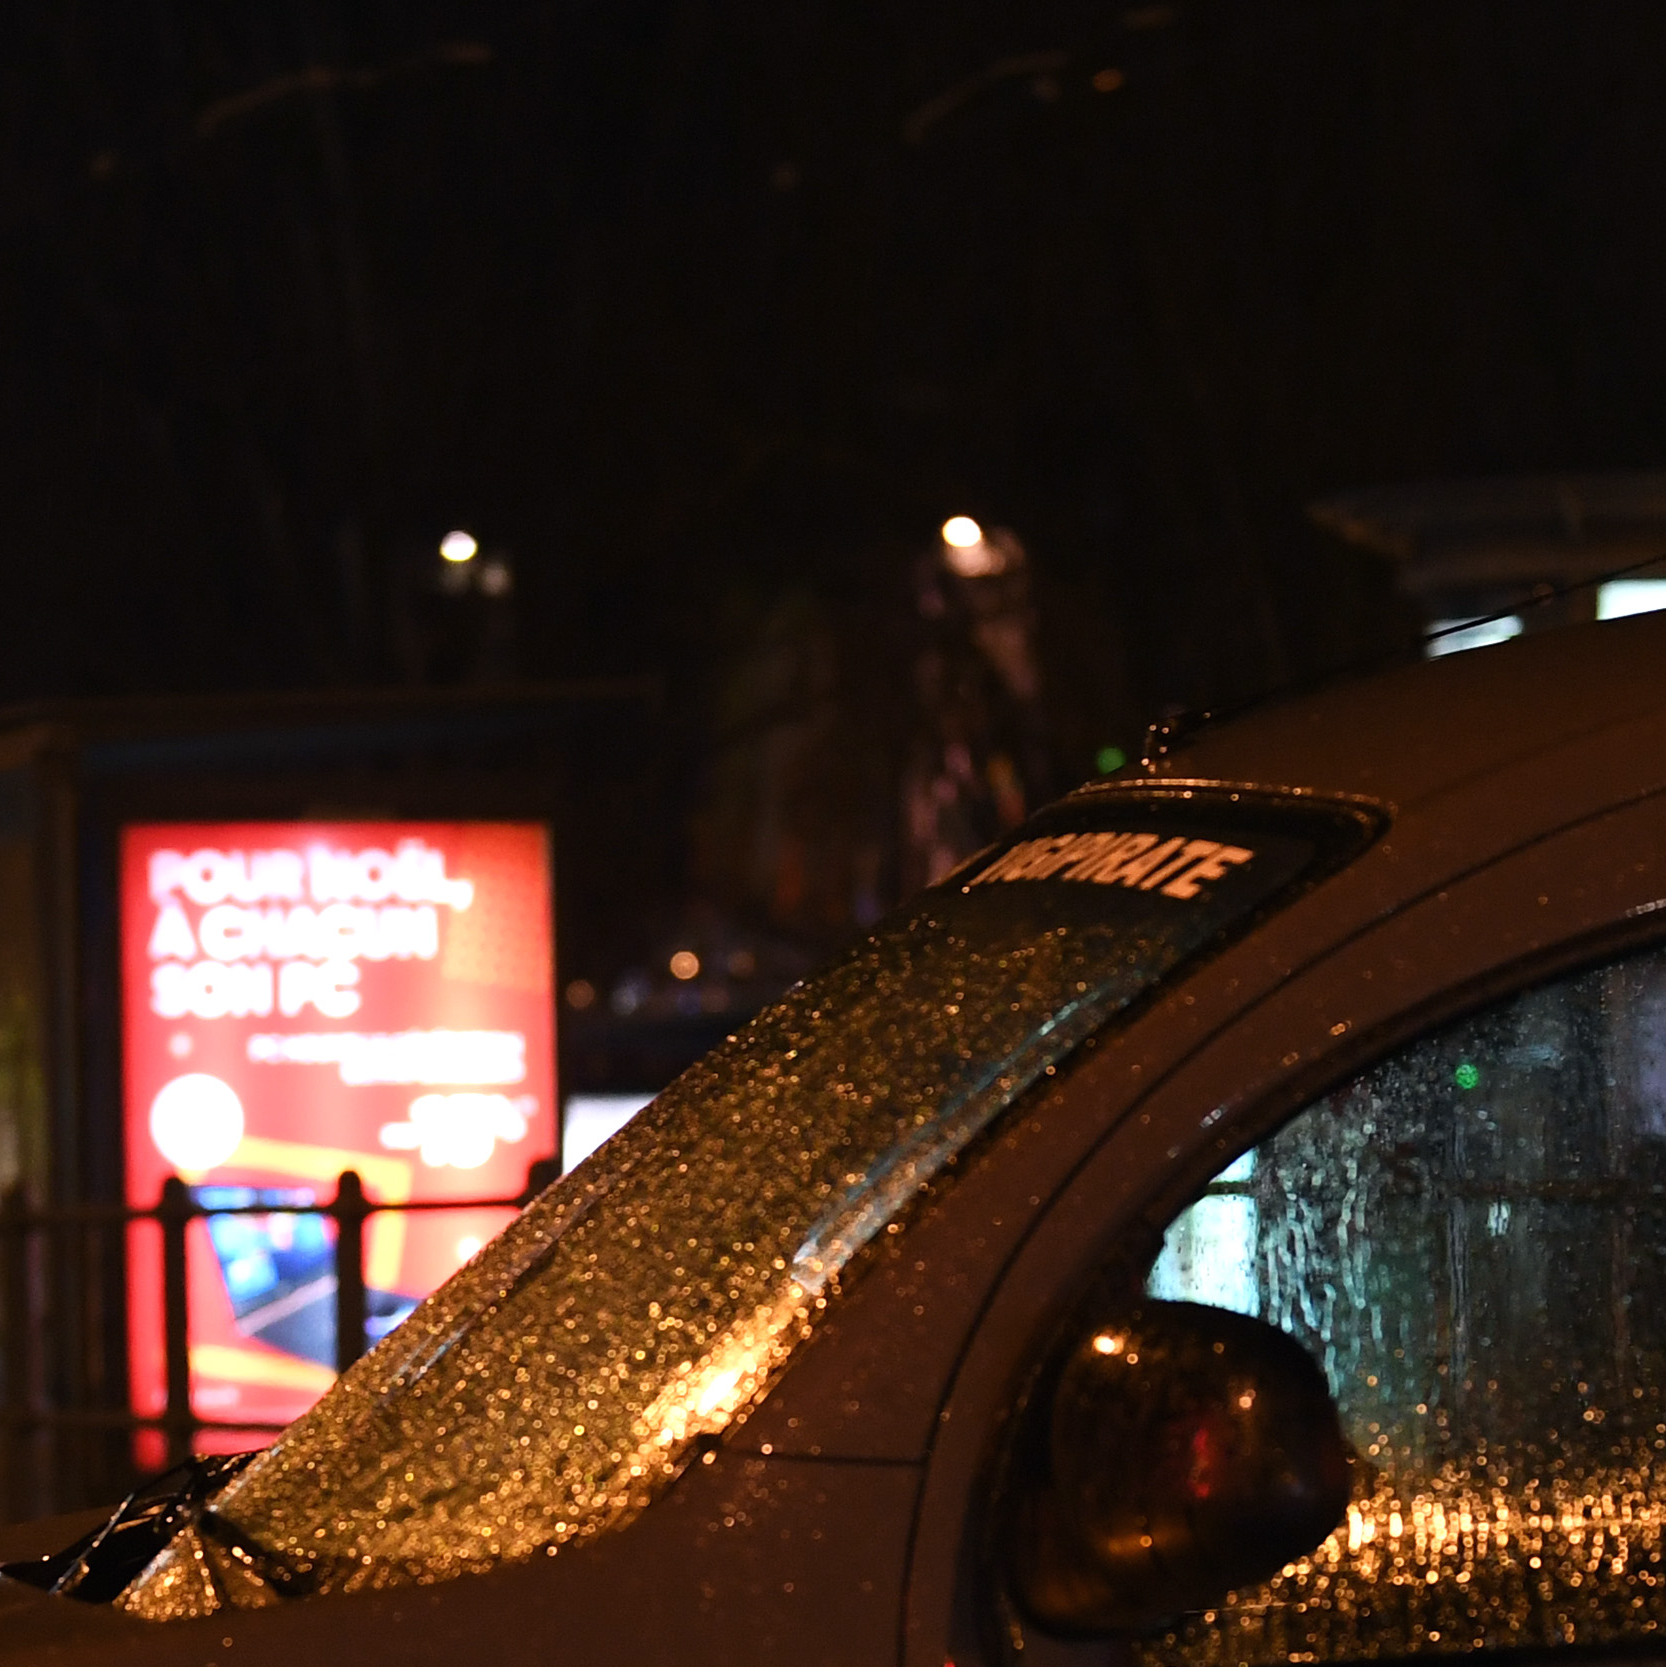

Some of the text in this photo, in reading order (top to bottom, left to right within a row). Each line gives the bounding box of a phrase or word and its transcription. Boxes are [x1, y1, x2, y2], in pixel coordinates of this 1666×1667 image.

[152, 852, 303, 904] POUR
[199, 904, 438, 960] CHACUN
[153, 960, 361, 1018] SON PC
